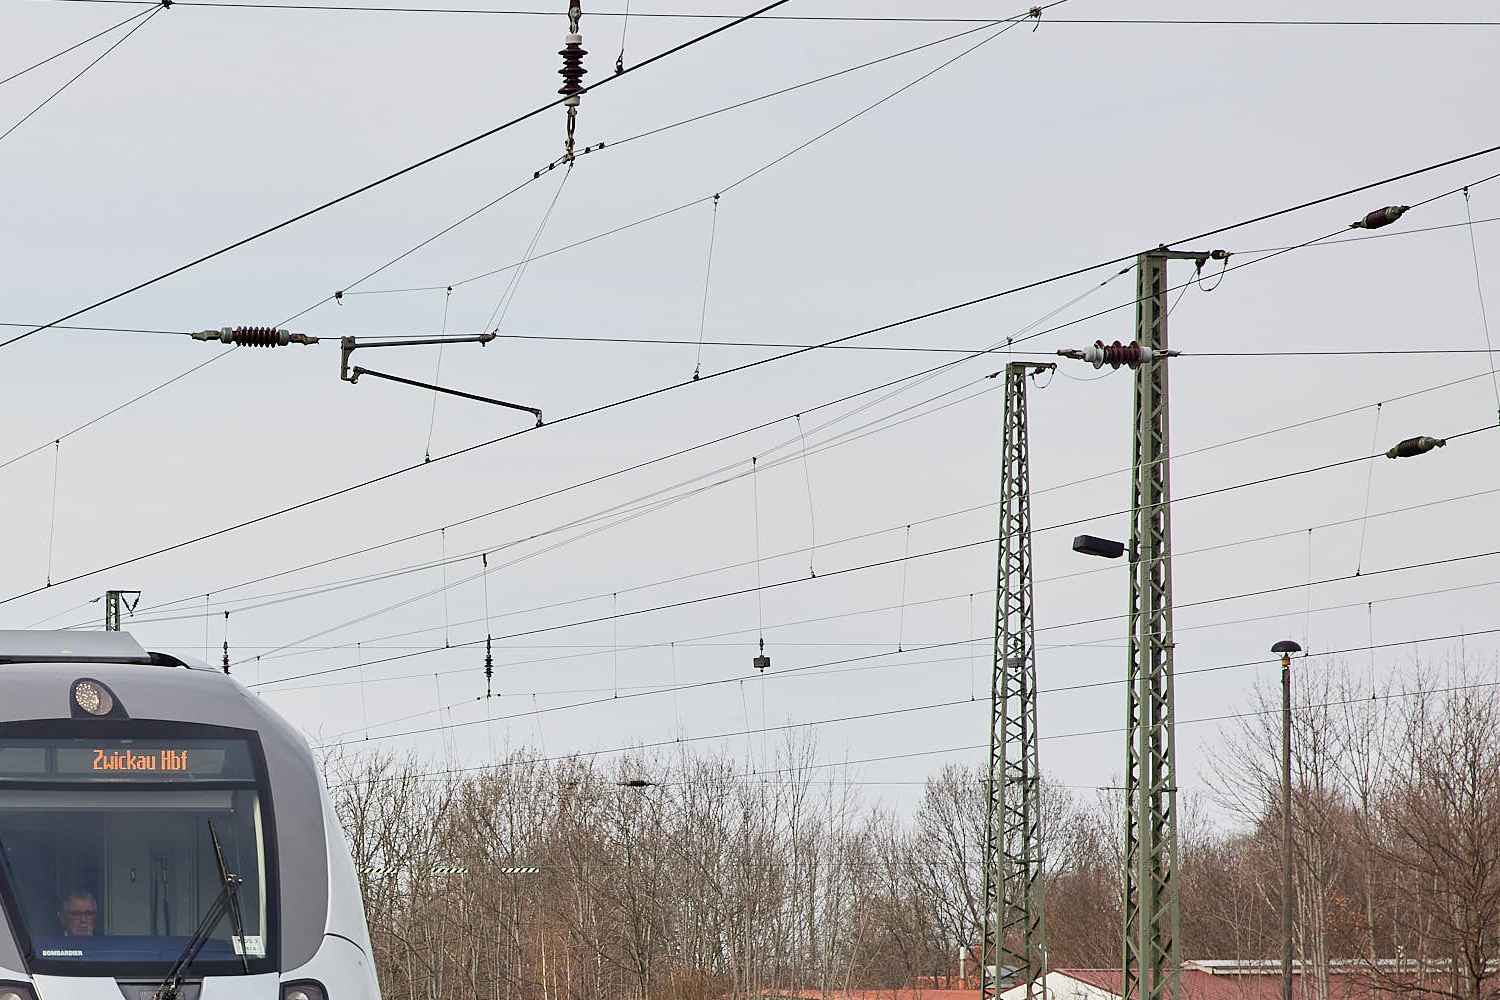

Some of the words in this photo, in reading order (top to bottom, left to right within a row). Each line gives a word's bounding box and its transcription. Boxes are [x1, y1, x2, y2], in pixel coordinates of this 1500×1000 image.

[93, 749, 156, 771] Zwickau
[161, 750, 188, 771] Hbf
[41, 949, 84, 957] BOMBARDIER
